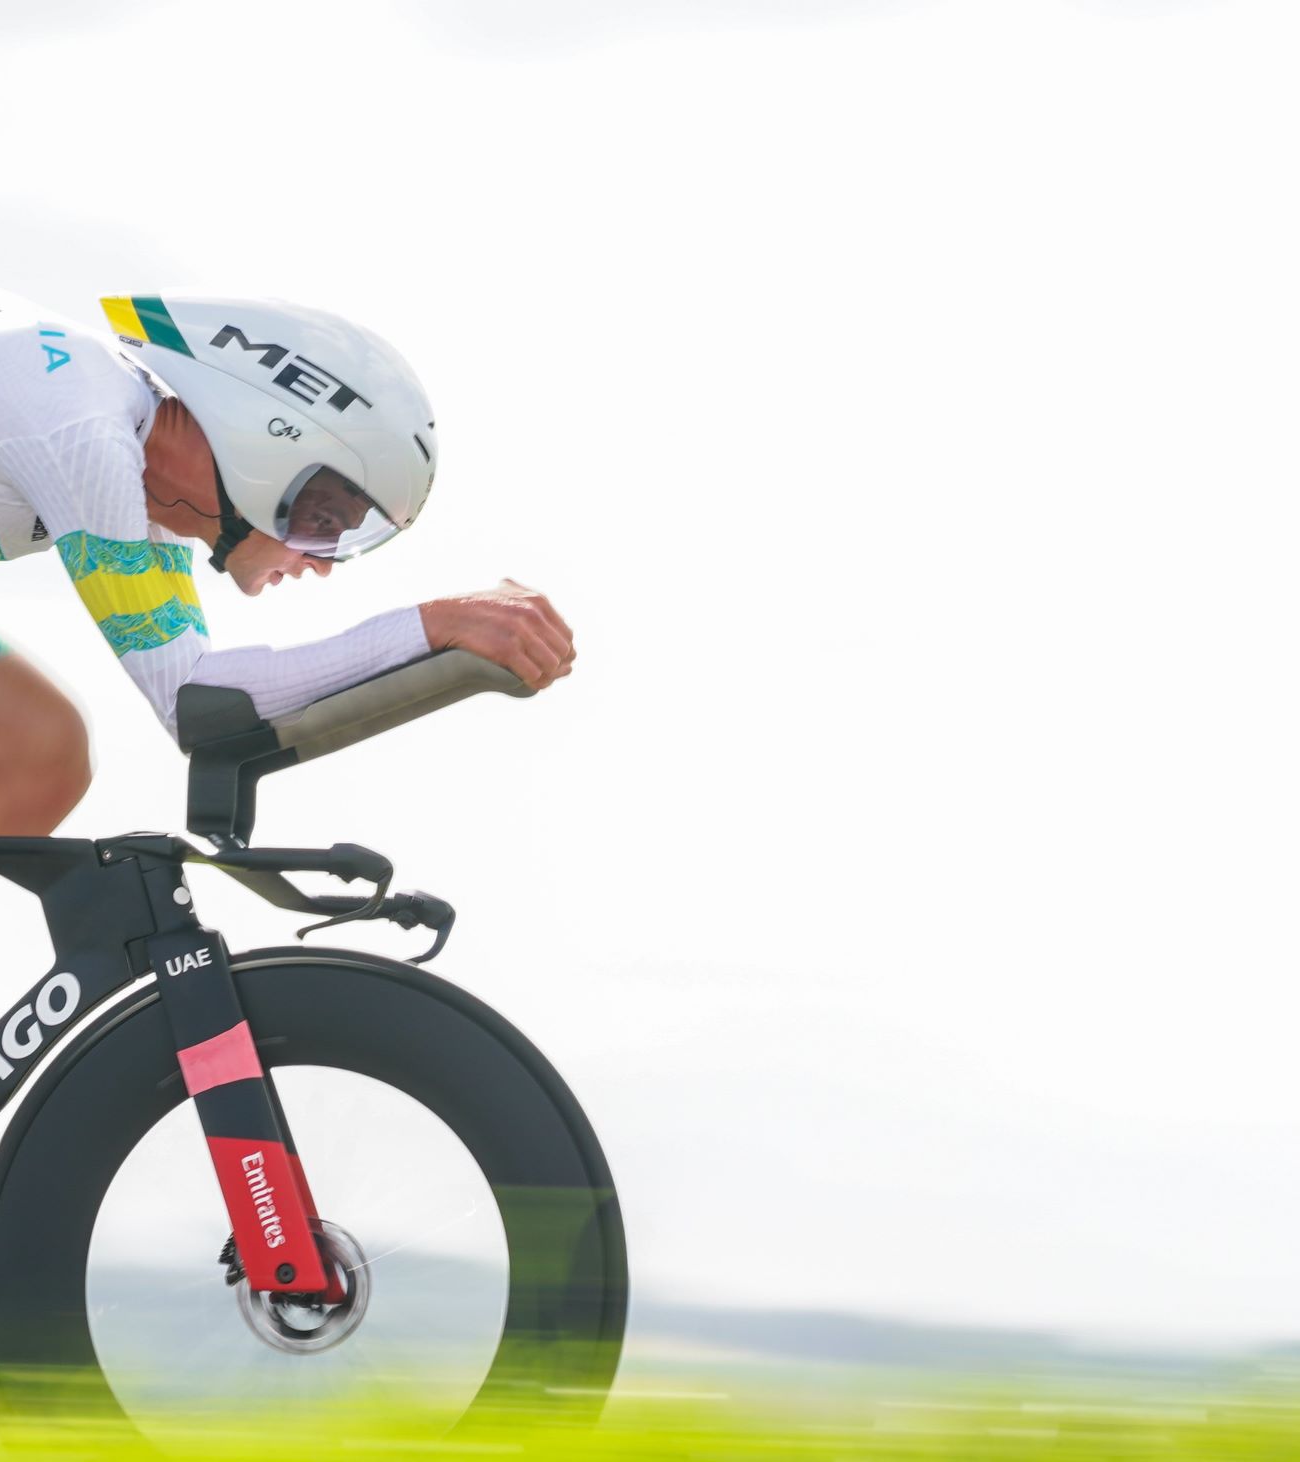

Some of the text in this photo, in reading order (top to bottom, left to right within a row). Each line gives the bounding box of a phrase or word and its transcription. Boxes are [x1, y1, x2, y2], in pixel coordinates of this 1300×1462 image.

[209, 324, 373, 413] MET
[165, 947, 213, 977] UAE
[241, 1151, 286, 1249] Emirates
